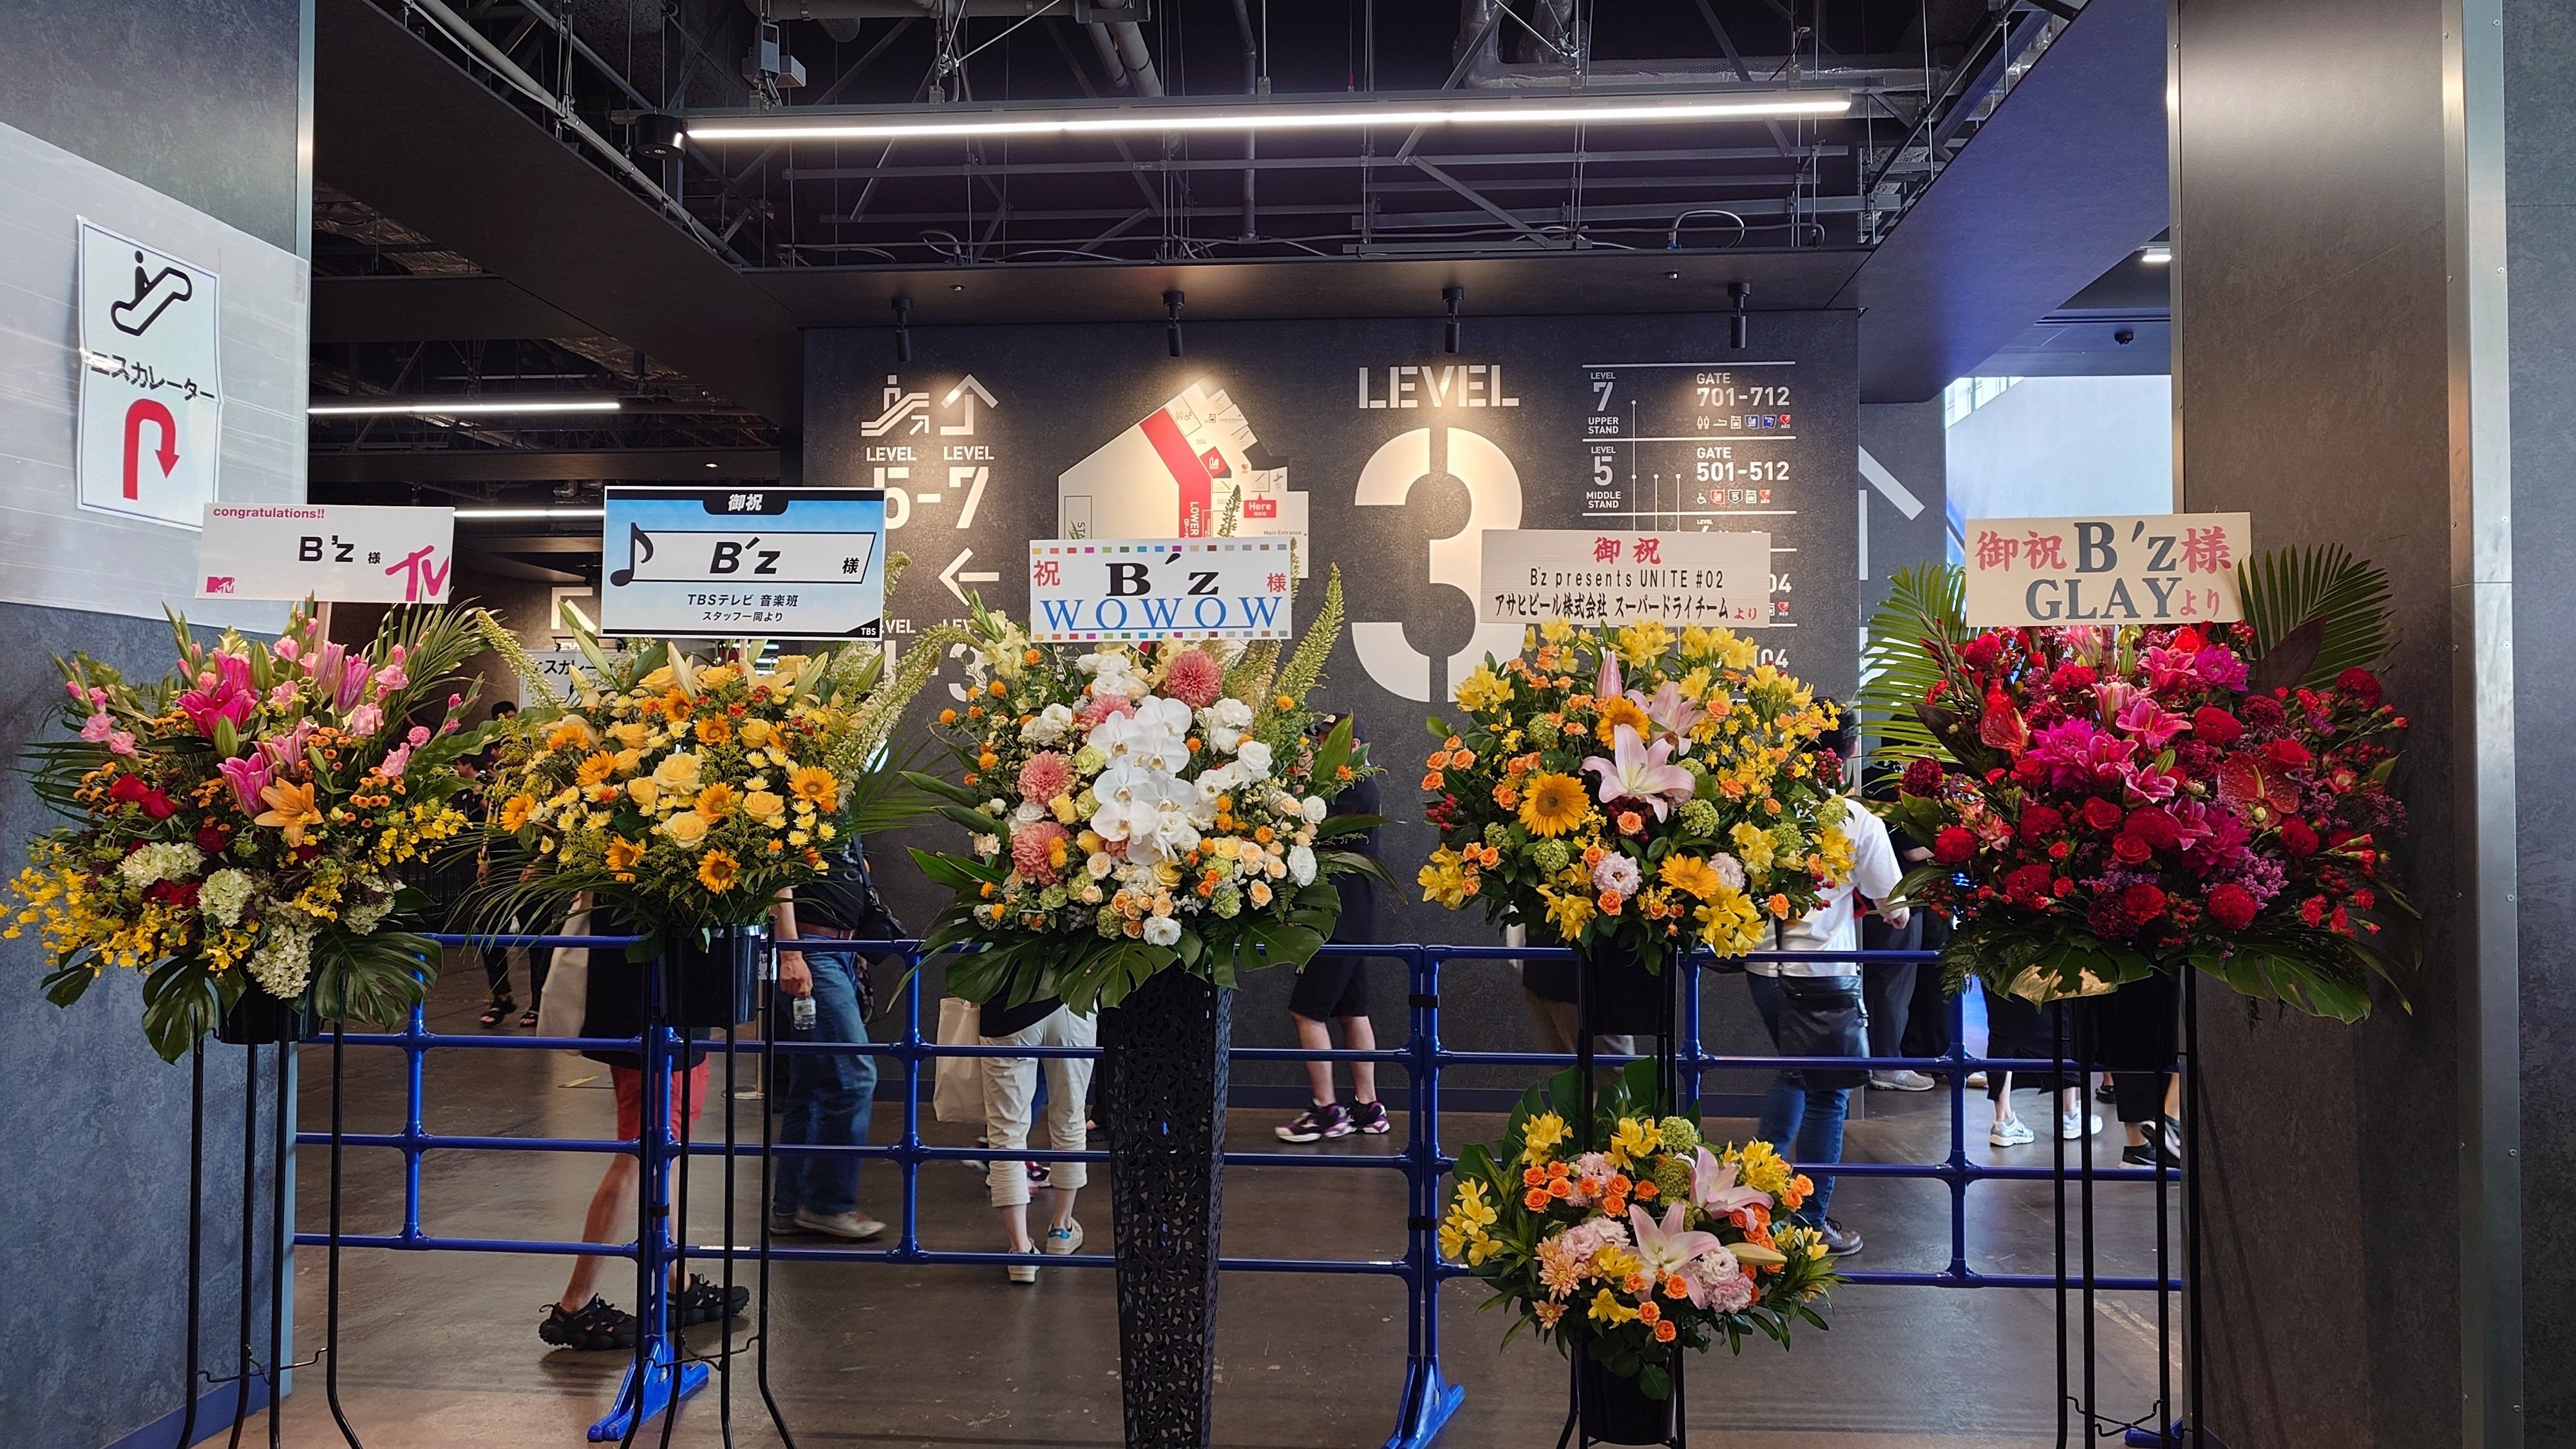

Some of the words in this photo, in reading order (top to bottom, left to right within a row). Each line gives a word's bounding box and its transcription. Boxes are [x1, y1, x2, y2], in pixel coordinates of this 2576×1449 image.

[90, 350, 215, 401] エスカレーター
[1696, 372, 1731, 384] GATE
[1358, 365, 1519, 408] LEVEL
[1593, 381, 1614, 412] 7
[1696, 386, 1790, 406] 701-712
[1587, 417, 1619, 426] UPPER
[1587, 426, 1619, 434] STAND
[866, 446, 918, 462] LEVEL
[943, 446, 995, 460] LEVEL
[1591, 446, 1616, 454] LEVEL
[1696, 446, 1732, 459] GATE
[1594, 456, 1613, 486] 5
[1696, 461, 1790, 481] 501-512
[727, 493, 764, 512] 御祝
[1586, 491, 1621, 500] MIDDLE
[1248, 501, 1272, 511] Here
[1587, 500, 1620, 509] STAND
[213, 507, 325, 519] congratulations!!
[1190, 501, 1199, 536] LOWER
[367, 551, 381, 565] 様
[842, 557, 860, 574] 様
[1351, 426, 1526, 703] 3
[1032, 560, 1061, 587] 祝
[1267, 573, 1287, 593] 様
[1555, 570, 1633, 589] presents
[1640, 569, 1688, 588] UNITE
[1696, 570, 1724, 588] #02
[687, 593, 753, 607] TBSテレビ
[759, 594, 799, 607] 音楽班
[1494, 592, 1609, 620] アサヒビール株式会社
[1614, 594, 1730, 620] スーパードライチーム
[1733, 607, 1758, 621] より
[702, 611, 784, 623] スタッフ一同より
[1039, 596, 1283, 630] WOWOW
[860, 627, 877, 636] TBS
[882, 619, 916, 634] VEL
